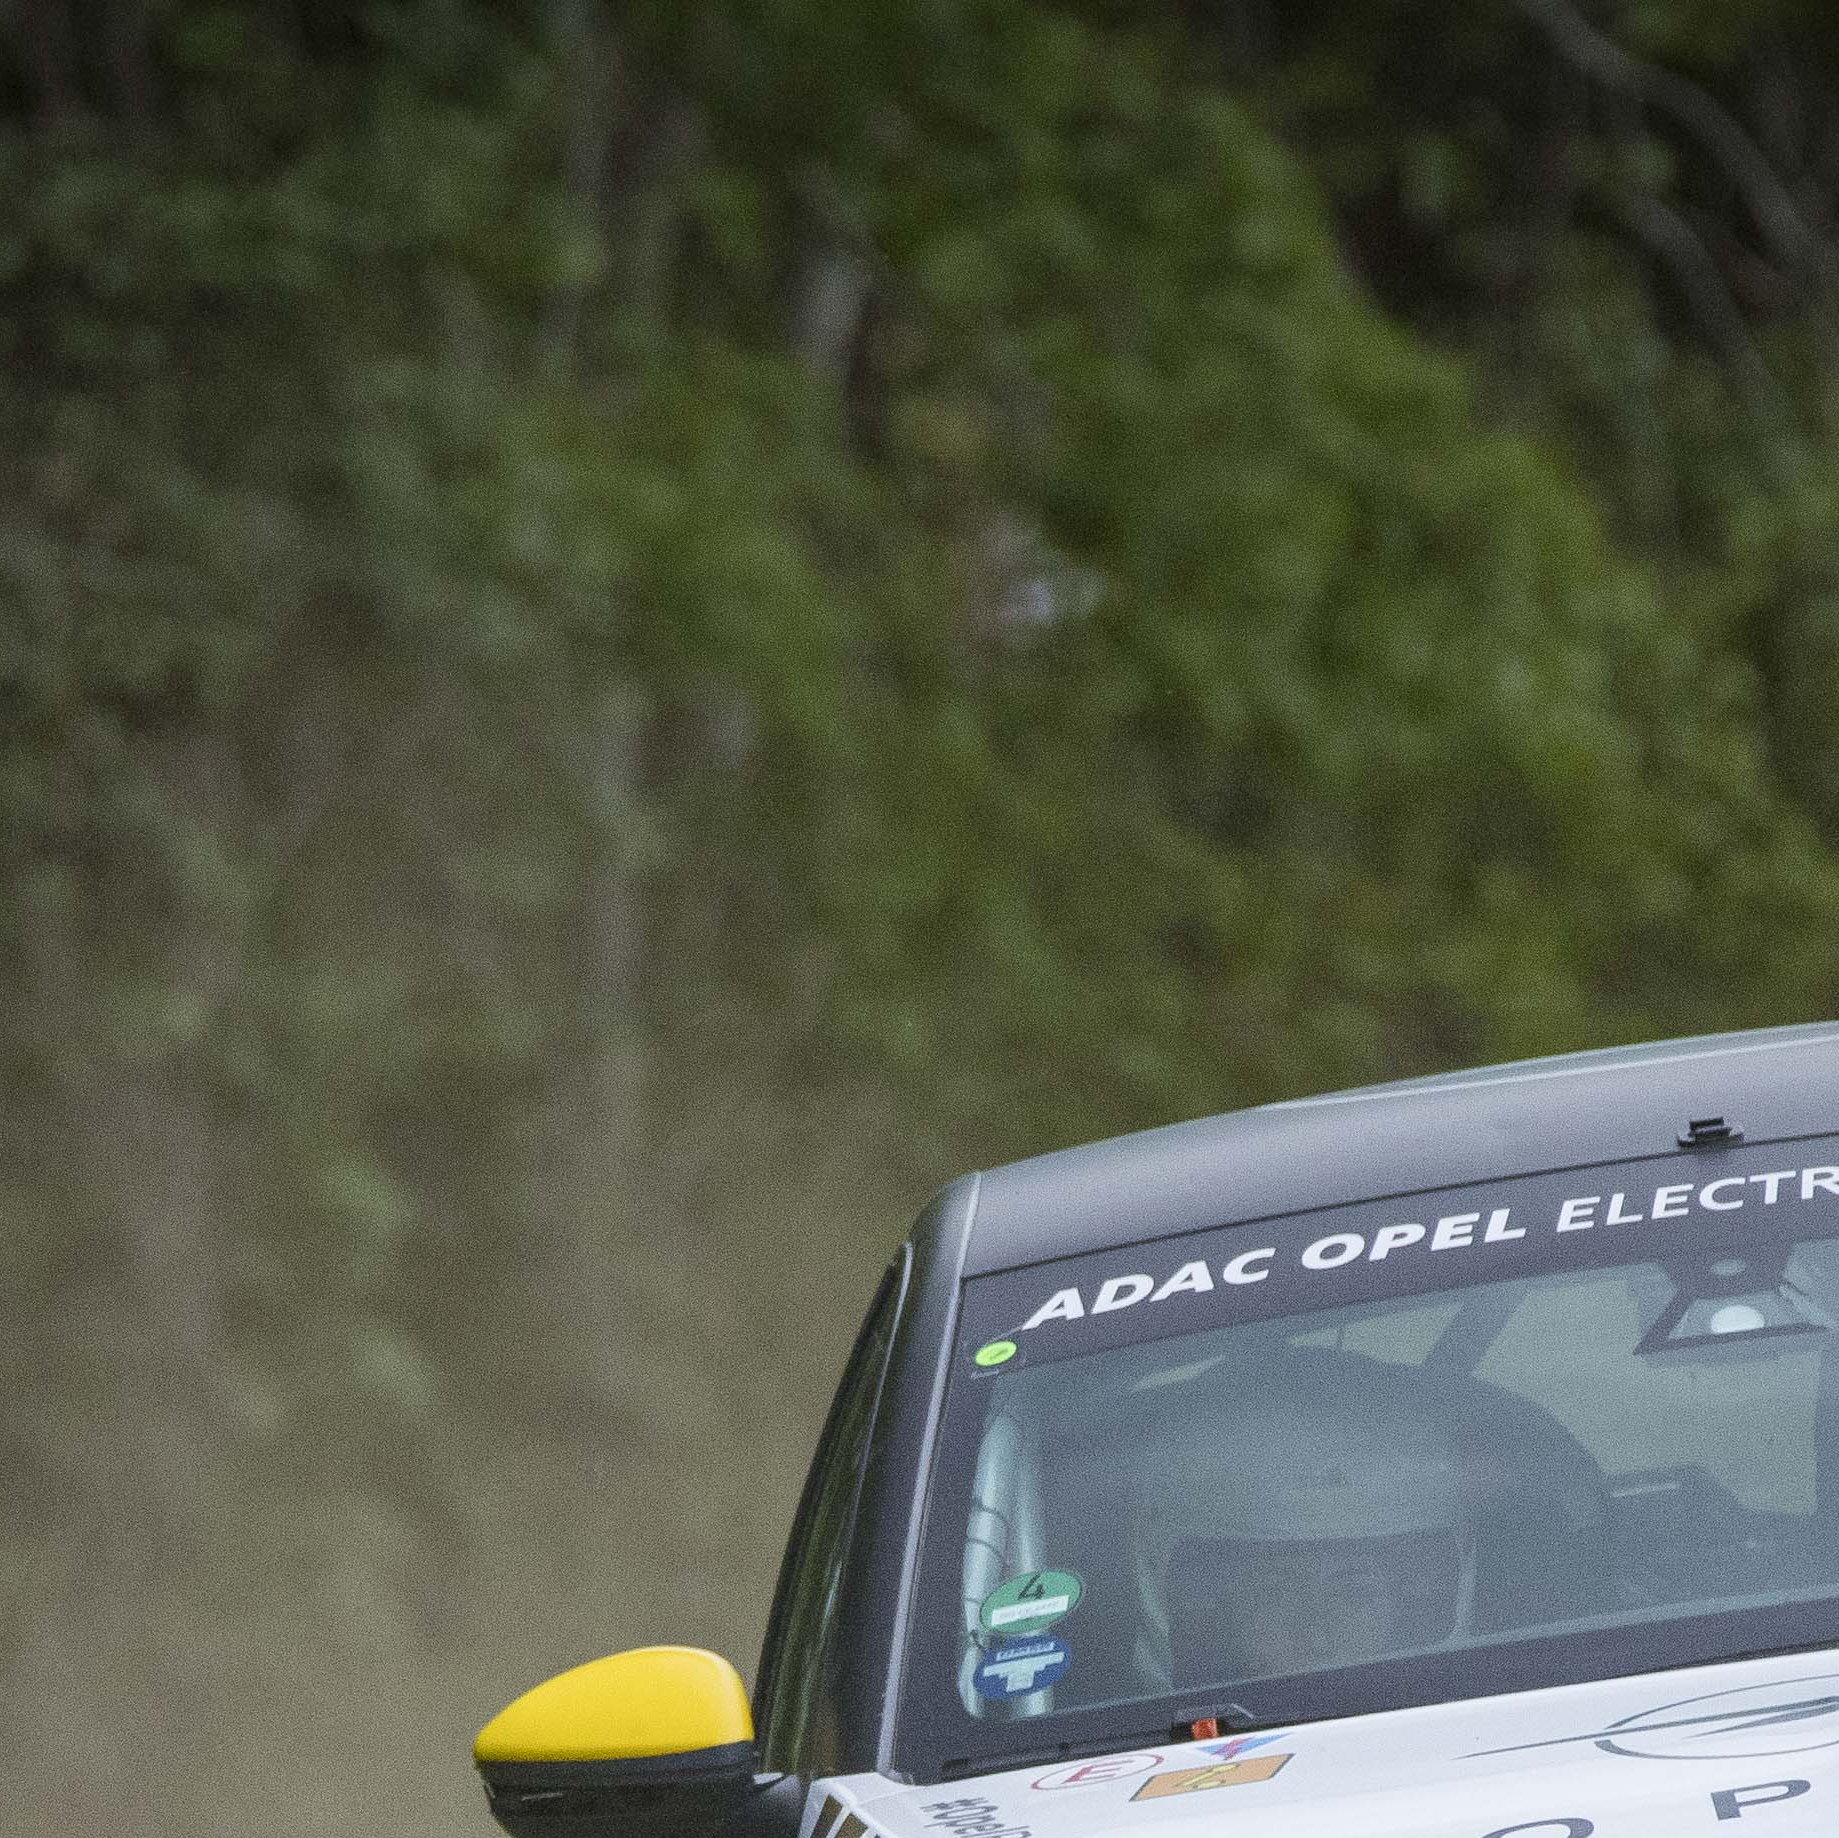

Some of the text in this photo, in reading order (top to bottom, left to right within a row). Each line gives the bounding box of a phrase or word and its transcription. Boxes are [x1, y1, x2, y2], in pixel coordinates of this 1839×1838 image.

[1022, 1247, 1277, 1331] ADAC
[1300, 1207, 1528, 1272] OPEL
[1017, 1573, 1045, 1600] 4
